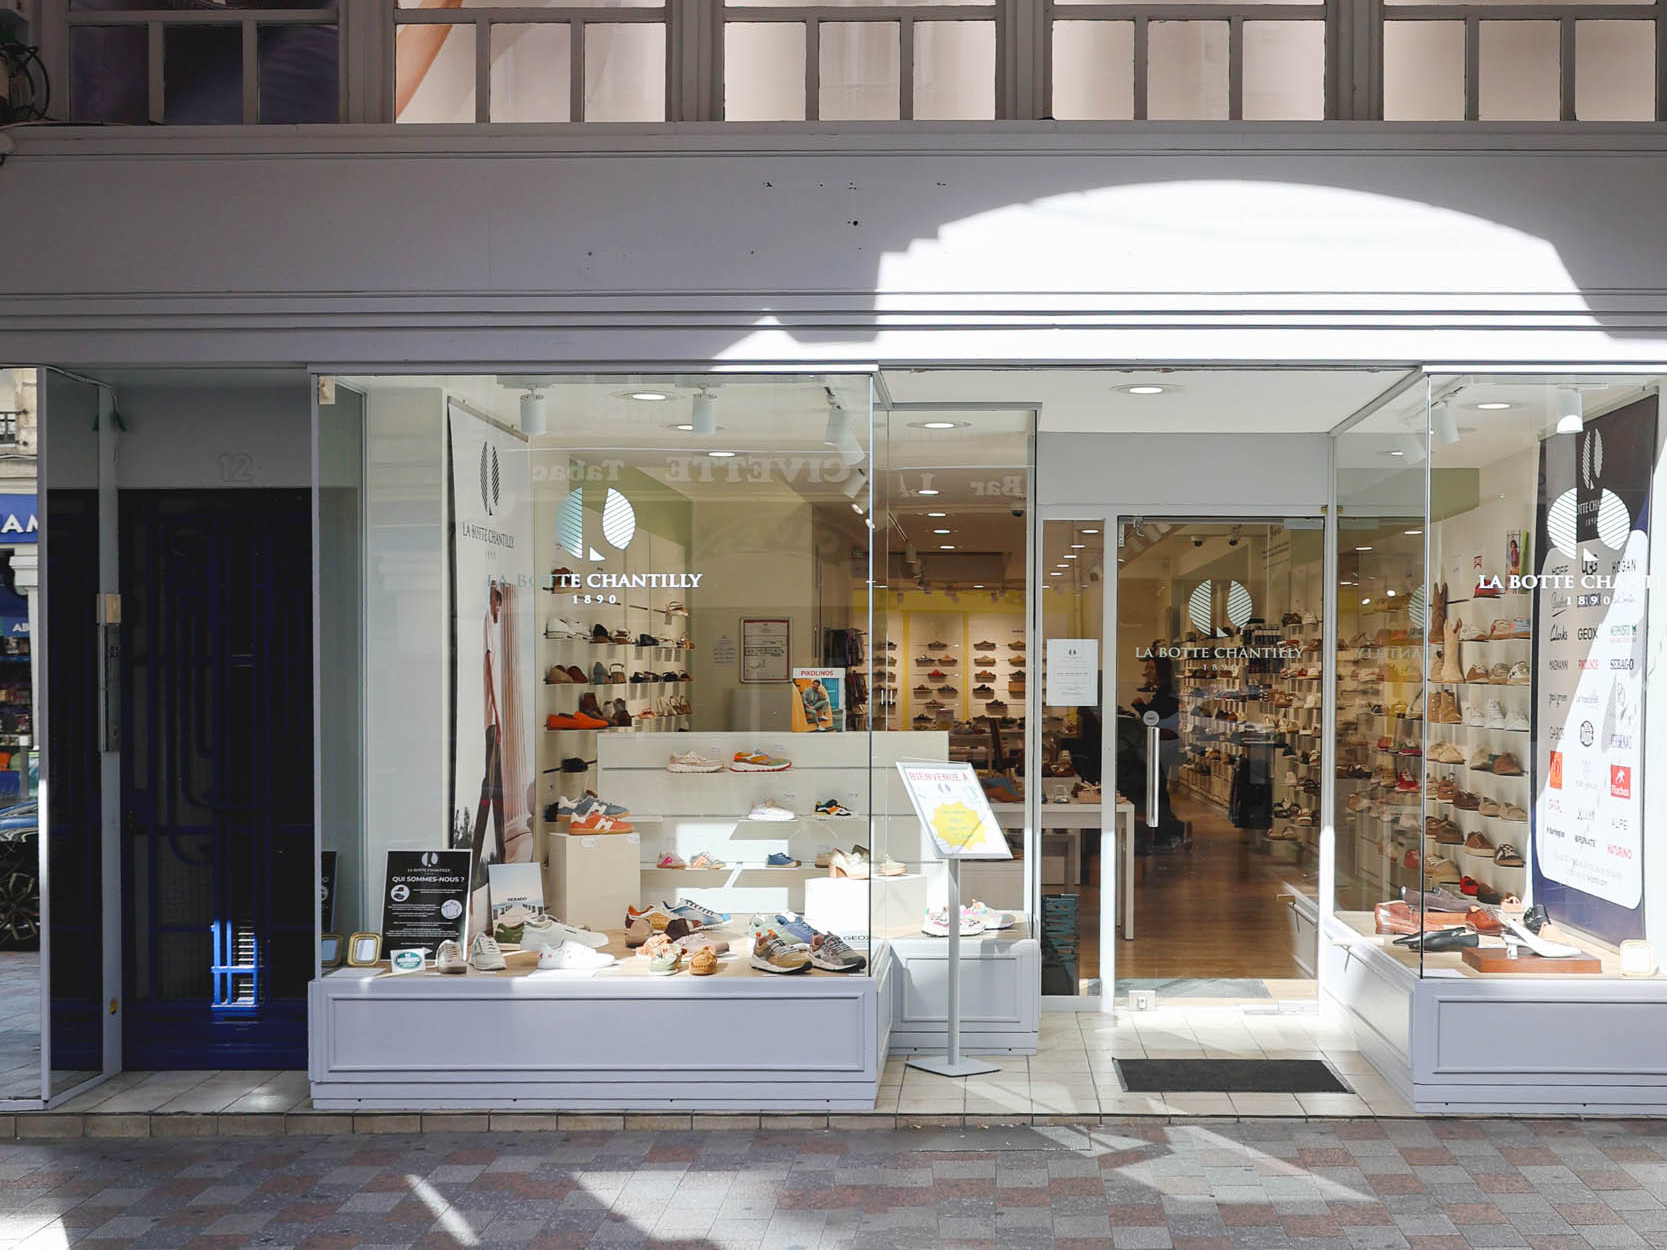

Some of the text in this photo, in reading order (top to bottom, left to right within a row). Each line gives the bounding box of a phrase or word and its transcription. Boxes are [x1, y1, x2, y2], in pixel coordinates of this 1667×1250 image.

[218, 453, 253, 482] 12
[487, 573, 511, 588] LA
[586, 573, 703, 588] CHANTILLY
[1479, 575, 1504, 589] LA
[1509, 575, 1574, 589] BOTTE
[572, 595, 616, 604] 1890
[1567, 596, 1610, 606] 1890
[1577, 627, 1598, 641] GEOX
[1135, 647, 1304, 658] LA BOTTE CHANTILLY
[908, 772, 961, 782] BIENVENUE
